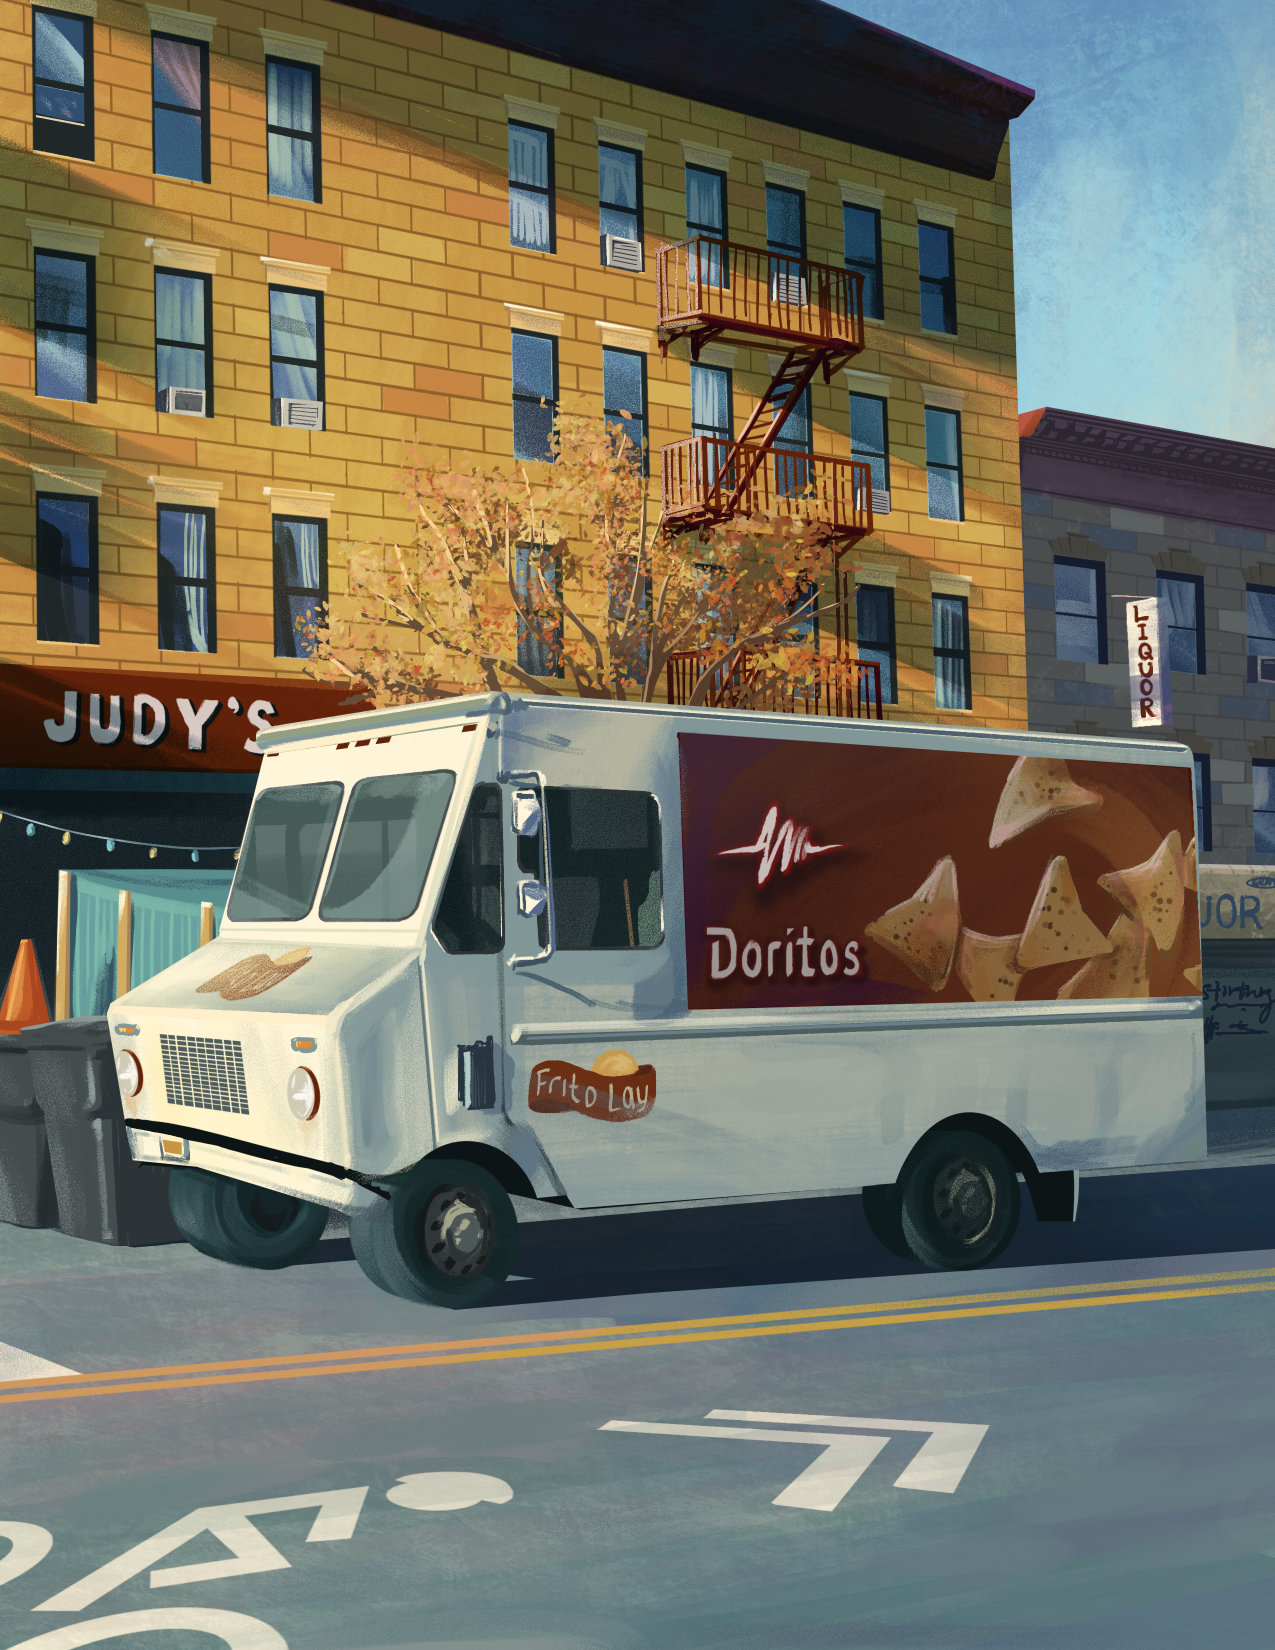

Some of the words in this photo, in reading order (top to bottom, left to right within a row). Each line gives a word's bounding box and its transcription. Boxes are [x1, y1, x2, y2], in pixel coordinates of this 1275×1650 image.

[1132, 604, 1157, 718] LIQUOR
[43, 690, 280, 755] JUDY'S
[706, 925, 860, 980] Doritos
[536, 1067, 598, 1108] Frito
[608, 1083, 649, 1113] Lay
